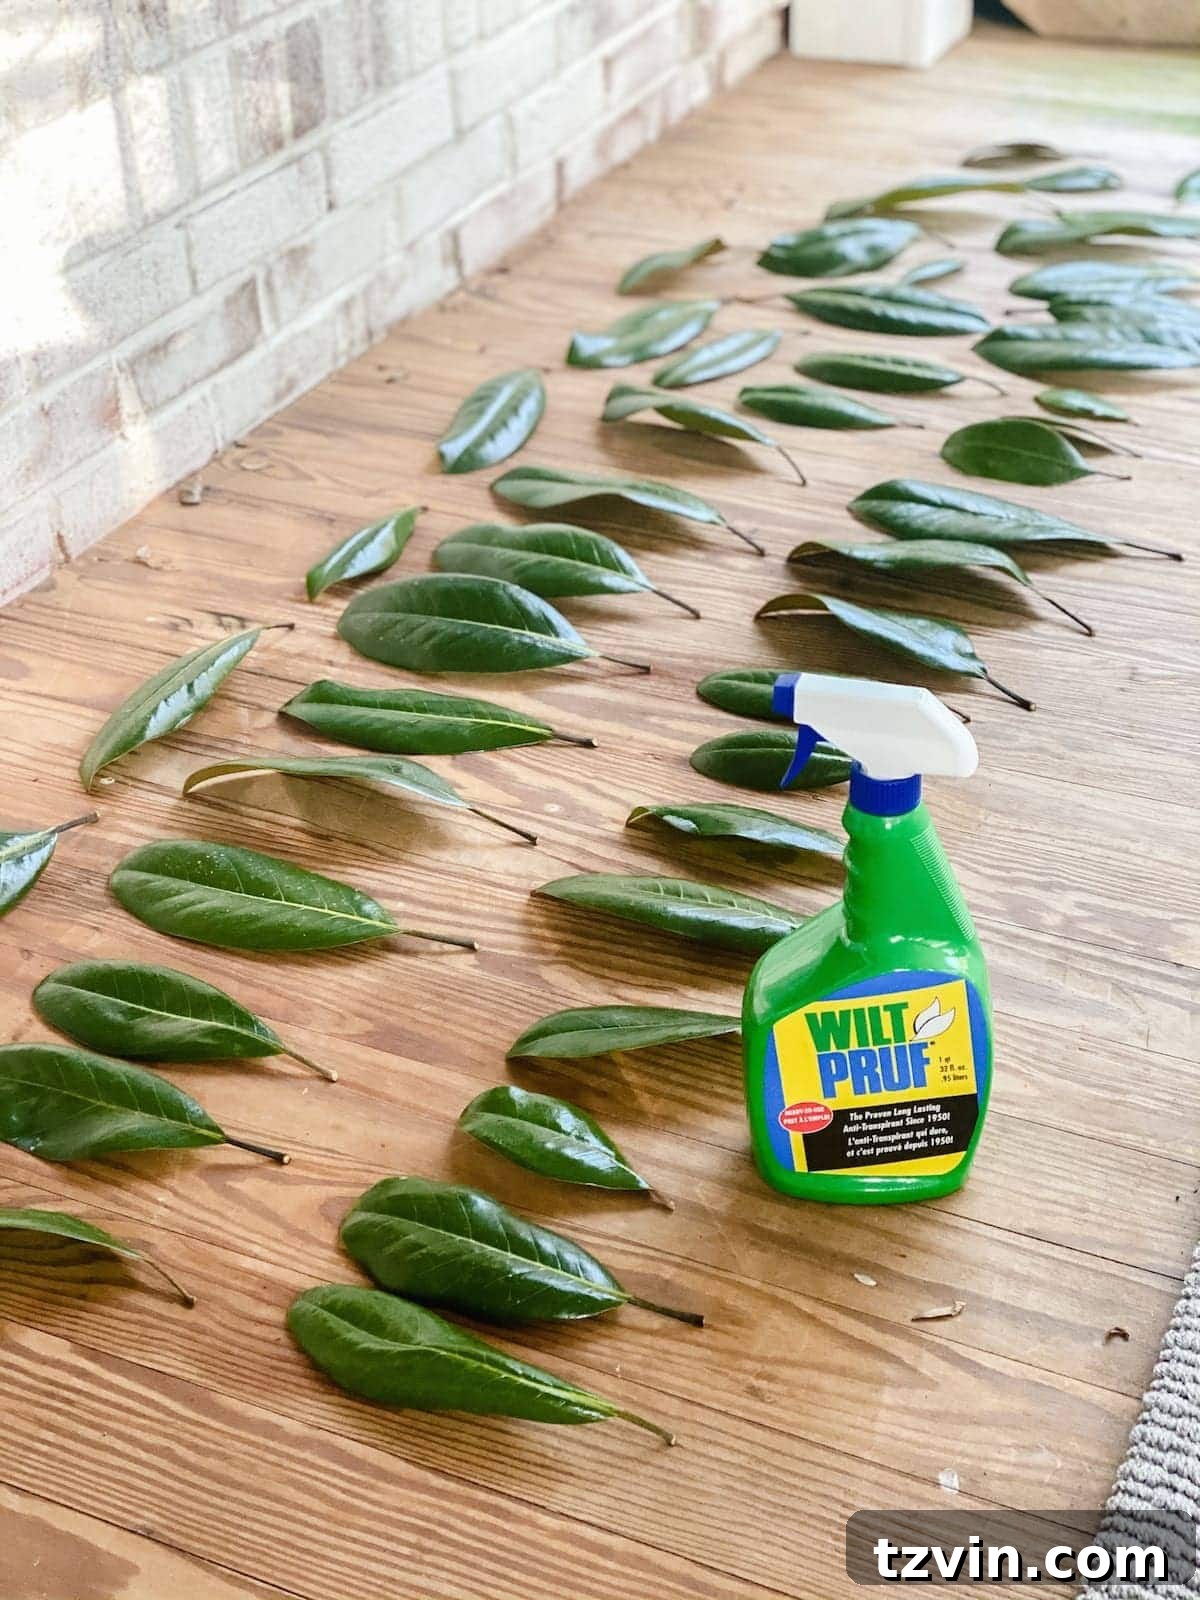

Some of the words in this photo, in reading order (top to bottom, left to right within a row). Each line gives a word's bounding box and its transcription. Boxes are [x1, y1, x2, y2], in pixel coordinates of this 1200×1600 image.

[805, 1002, 908, 1052] WILT
[817, 1041, 931, 1099] PRUF
[843, 1119, 904, 1133] Anti-Transpirant
[905, 1116, 925, 1126] Since
[927, 1111, 951, 1123] 1950!
[849, 1112, 863, 1121] The
[864, 1110, 892, 1120] Proven
[893, 1107, 912, 1117] Long
[913, 1103, 941, 1114] Lasting
[846, 1149, 855, 1158] et
[856, 1147, 874, 1157] c'est
[875, 1143, 903, 1157] prouvé
[903, 1139, 928, 1152] depuis
[930, 1135, 954, 1147] 1950!
[848, 1131, 914, 1146] L'anti-Transpirant
[915, 1128, 928, 1140] qui
